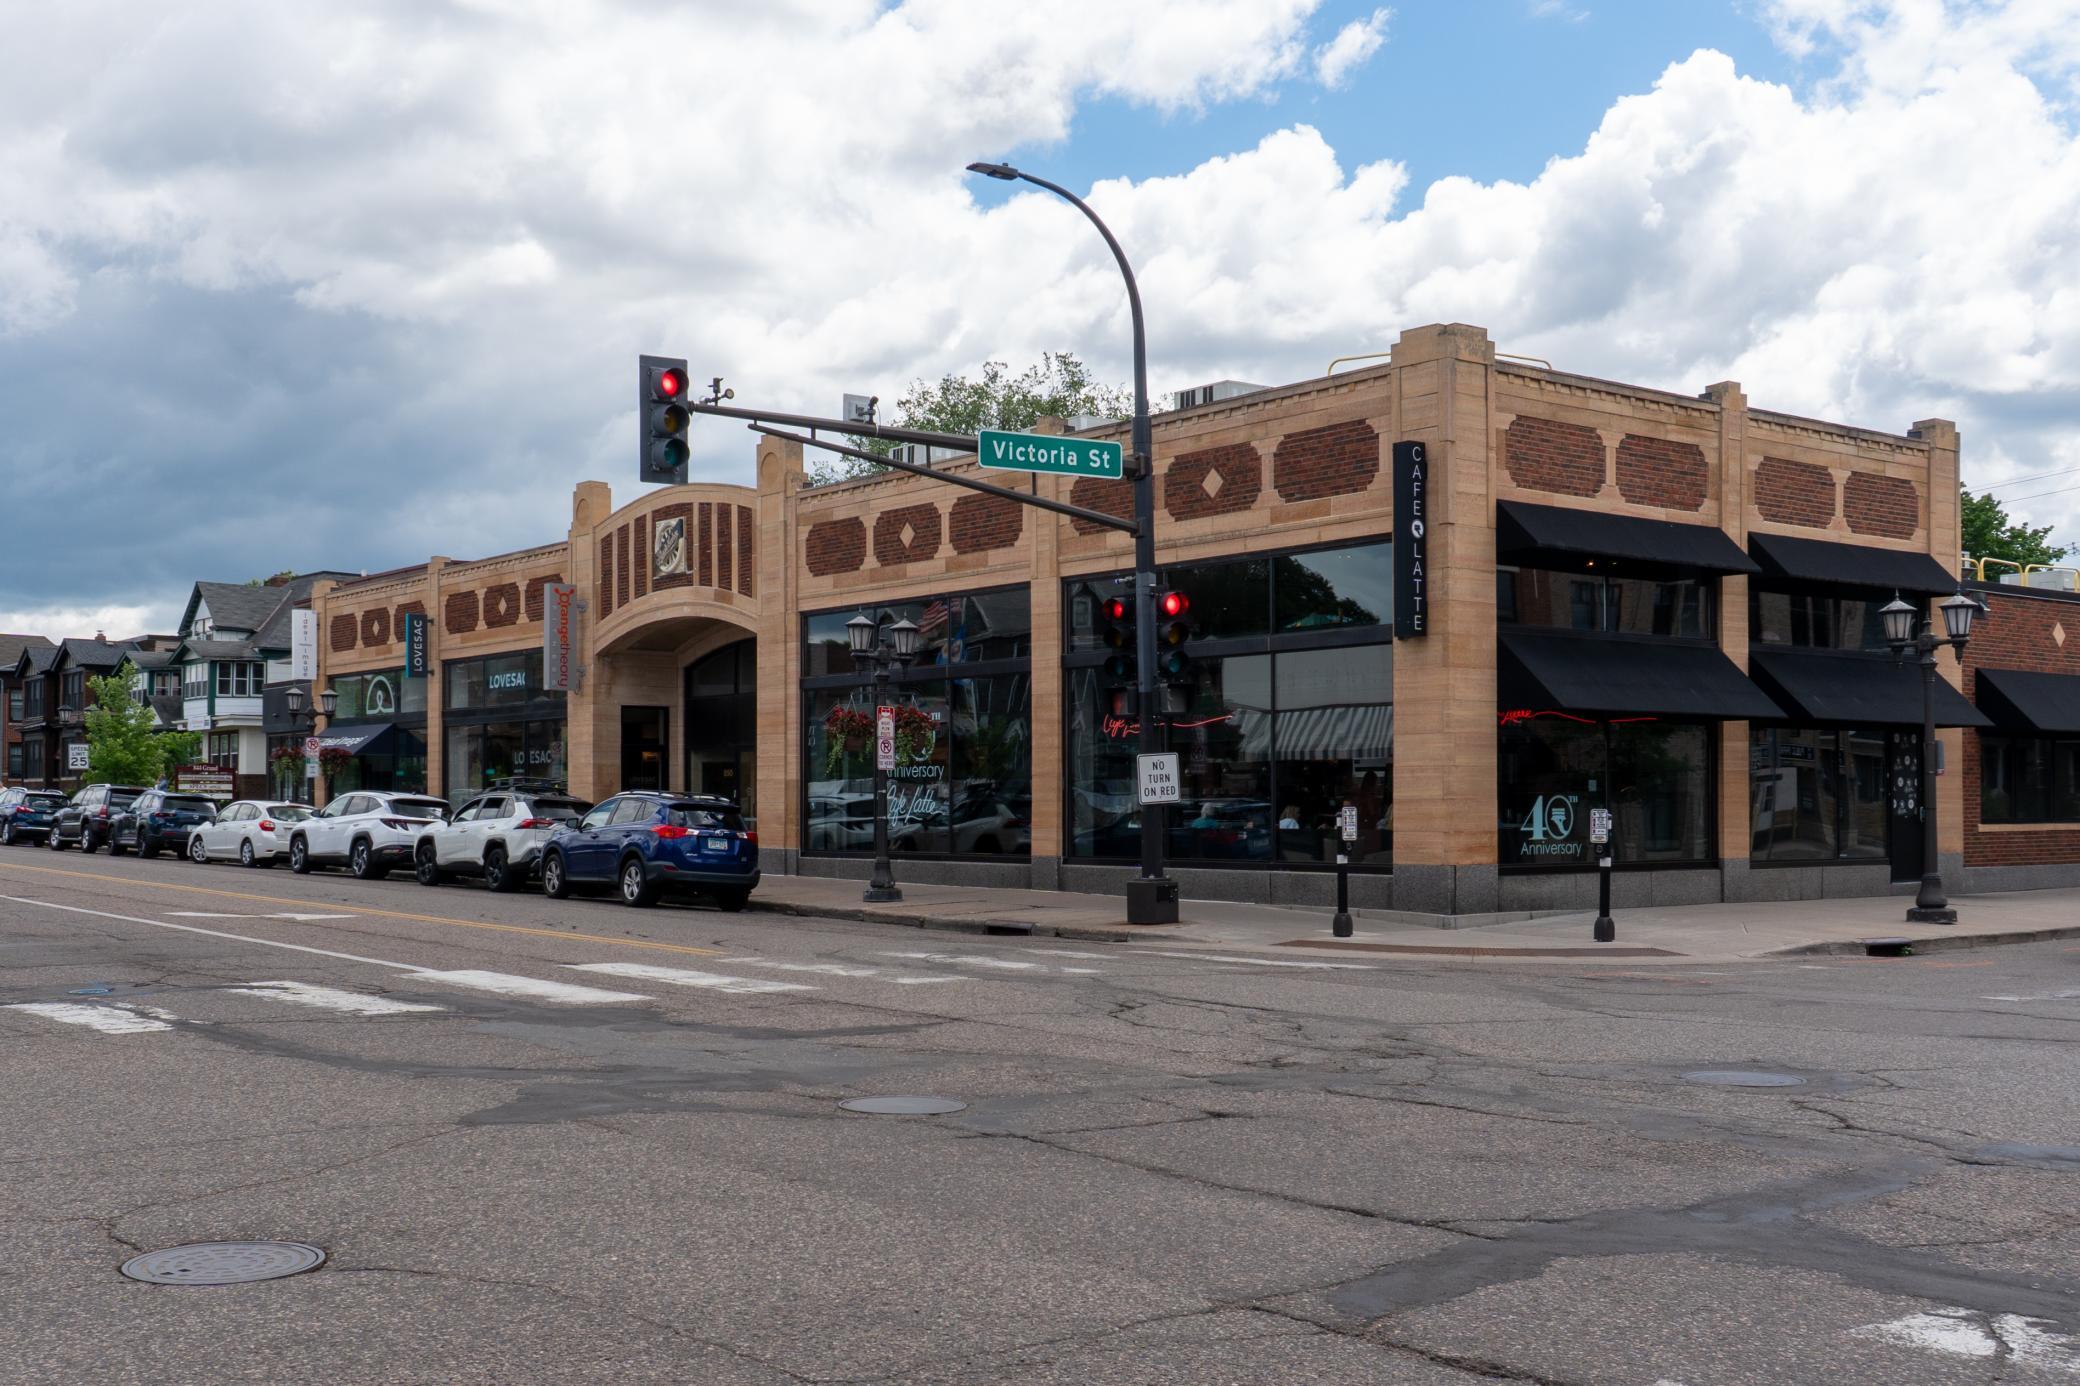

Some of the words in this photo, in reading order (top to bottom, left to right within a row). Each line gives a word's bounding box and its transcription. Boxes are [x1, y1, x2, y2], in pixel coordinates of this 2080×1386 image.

[992, 439, 1078, 466] Victoria
[1088, 449, 1110, 469] St
[1411, 446, 1423, 516] CAFE
[1412, 542, 1423, 631] LATTE
[552, 586, 576, 687] Orangetheory
[413, 619, 423, 672] LOVESAC
[489, 671, 526, 689] LOVESAC
[71, 756, 88, 766] 25
[514, 750, 552, 765] LOESAC
[1152, 761, 1165, 770] NO
[1148, 774, 1171, 784] TURN
[1144, 787, 1157, 797] ON
[1160, 786, 1176, 796] RED
[1520, 841, 1582, 857] Anniversary
